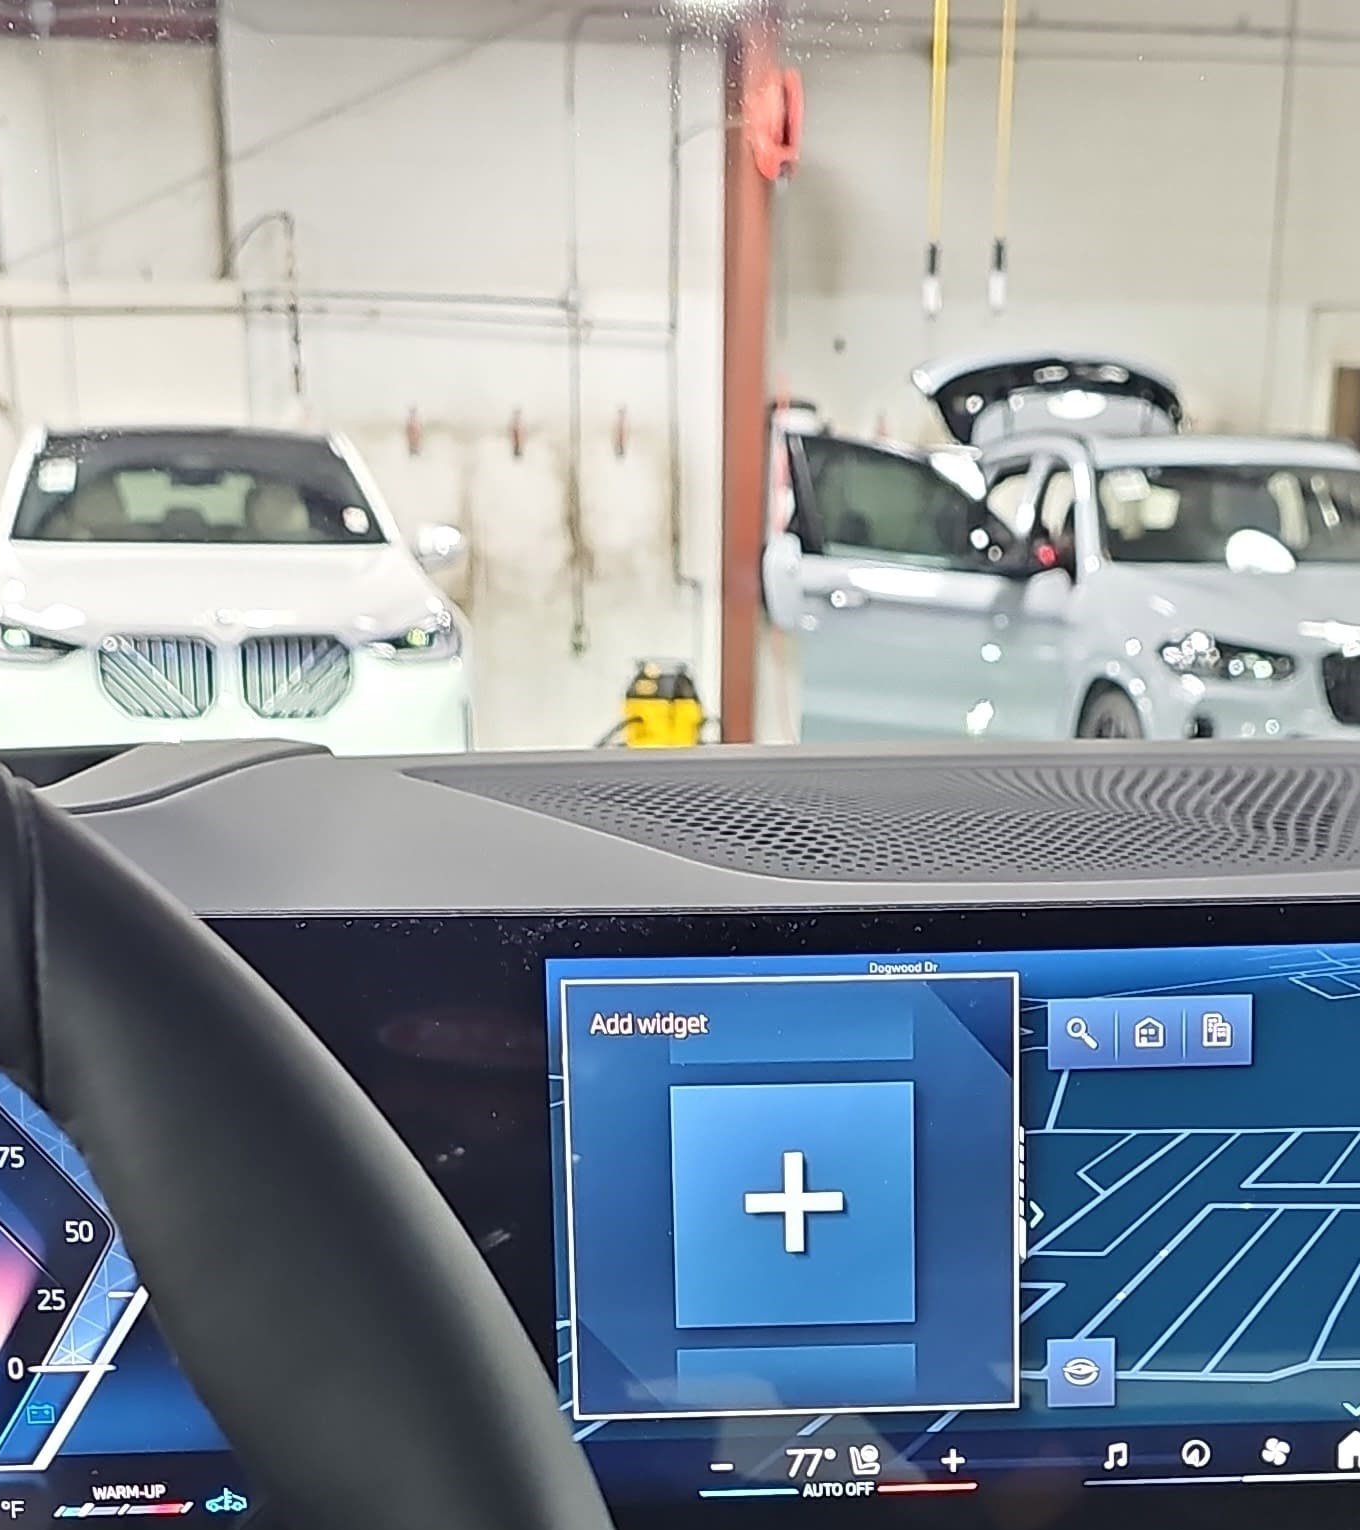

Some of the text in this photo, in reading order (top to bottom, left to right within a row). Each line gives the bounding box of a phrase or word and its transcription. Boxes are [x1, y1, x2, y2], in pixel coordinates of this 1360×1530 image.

[869, 961, 938, 975] Dogwood Dr
[590, 1013, 709, 1038] Add widget
[65, 1221, 94, 1243] 50
[37, 1289, 66, 1312] 25
[7, 1358, 25, 1380] 0
[92, 1484, 166, 1500] WARM-UP
[803, 1481, 874, 1497] AUTO OFF
